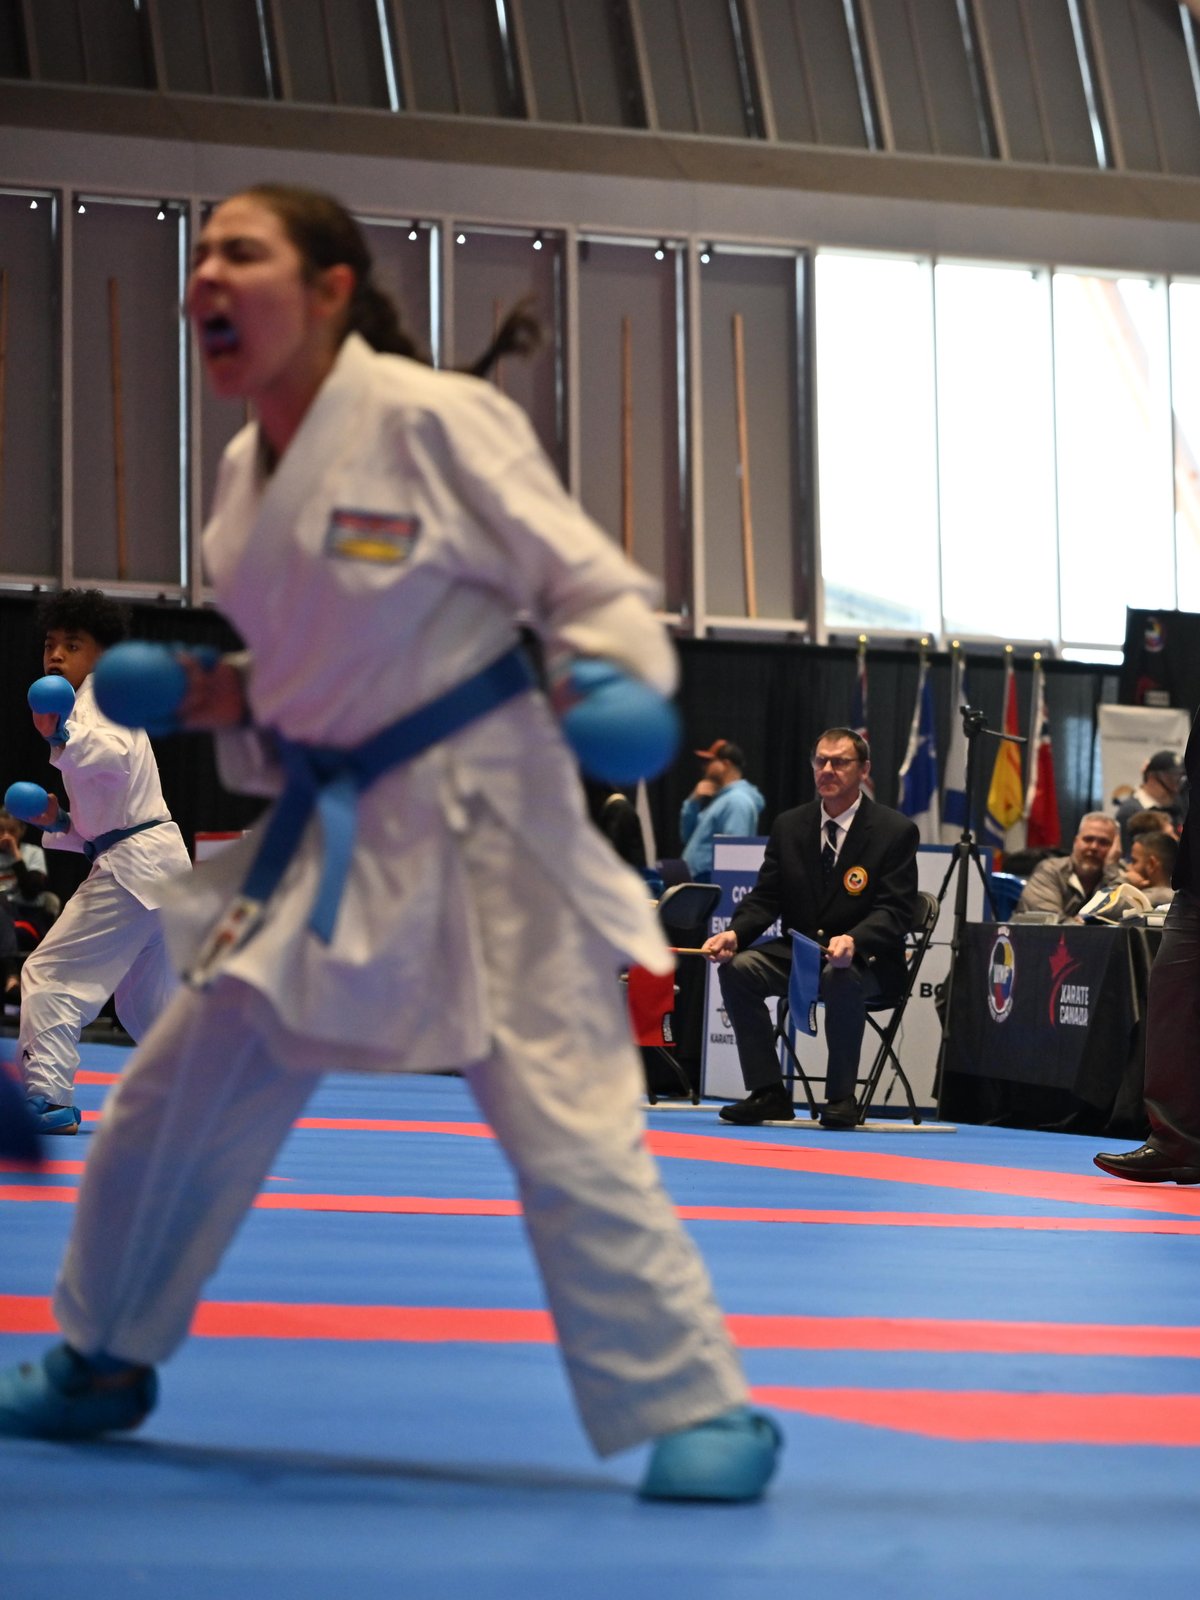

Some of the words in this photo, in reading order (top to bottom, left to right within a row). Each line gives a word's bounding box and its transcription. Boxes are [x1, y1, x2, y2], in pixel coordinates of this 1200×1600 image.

[1060, 984, 1089, 1005] KARATE
[1059, 1005, 1089, 1026] CANADA
[710, 1033, 735, 1045] KARATE
